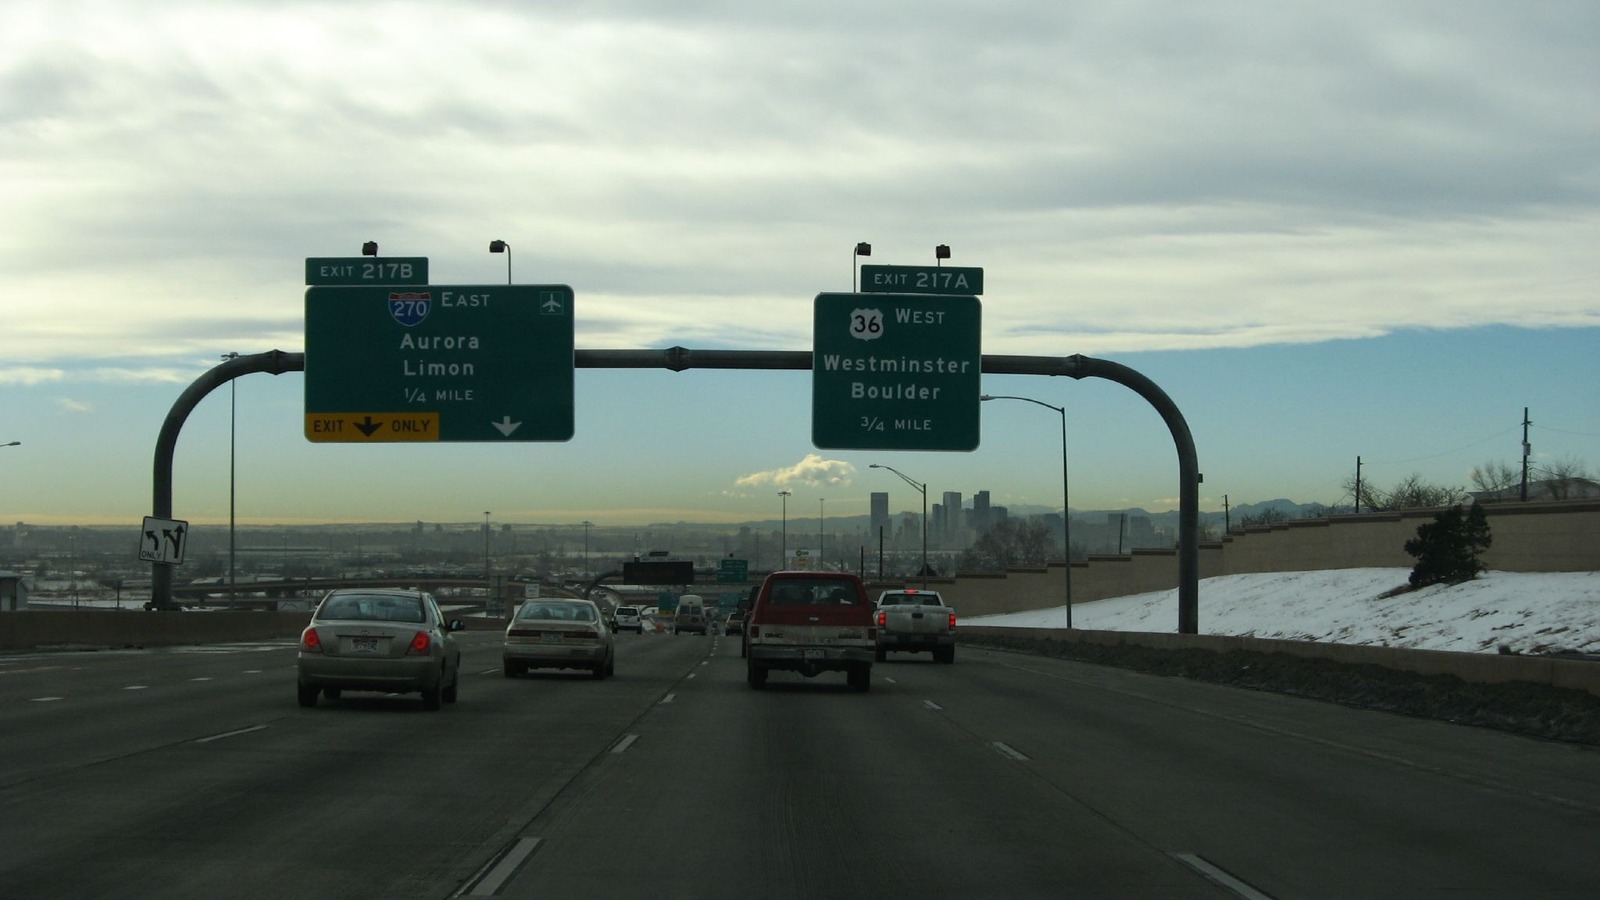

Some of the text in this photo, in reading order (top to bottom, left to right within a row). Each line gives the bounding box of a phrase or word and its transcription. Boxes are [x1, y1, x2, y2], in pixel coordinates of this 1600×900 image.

[320, 263, 413, 279] EXIT 217B
[874, 272, 969, 289] EXIT 217A
[394, 292, 490, 317] 270 EAST
[854, 308, 945, 333] 36 WEST
[400, 333, 480, 350] Aurora
[404, 359, 475, 376] Limon
[823, 354, 970, 374] Westminster
[404, 388, 474, 403] 1/4 MILE
[851, 382, 941, 400] Boulder
[313, 419, 431, 433] EXIT ONLY
[860, 416, 932, 432] 3/4 MILE
[141, 550, 161, 559] ONLY
